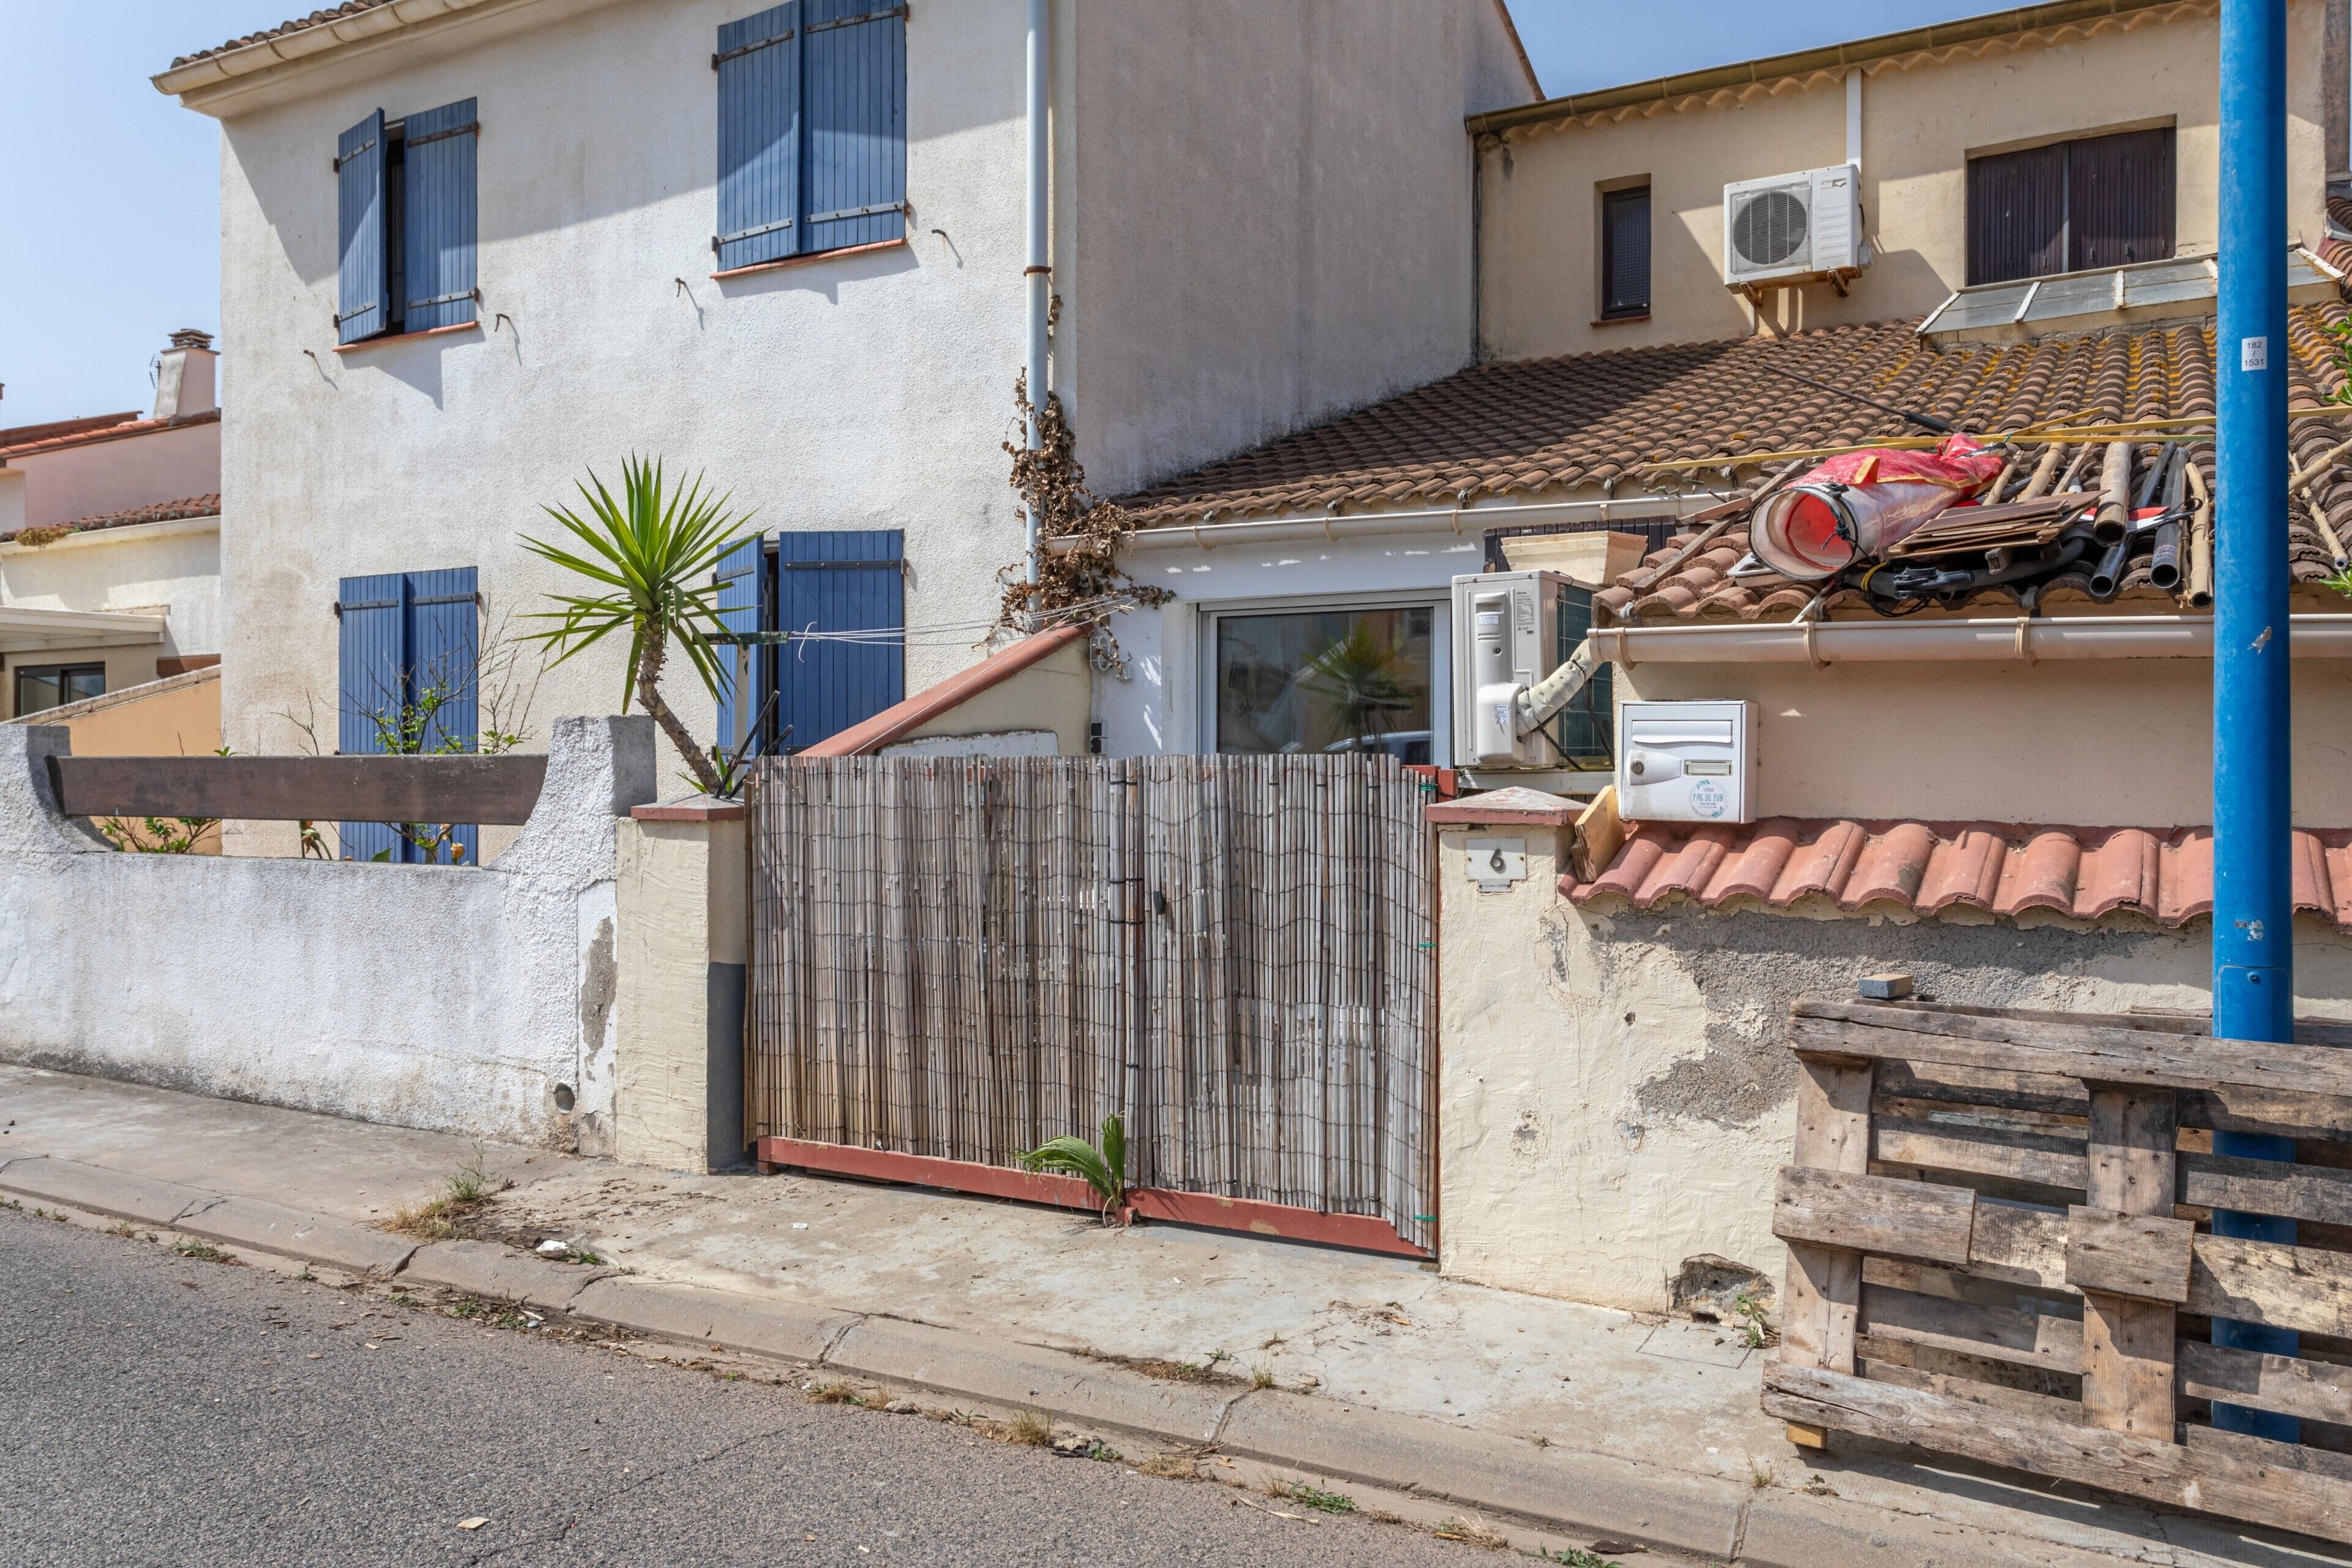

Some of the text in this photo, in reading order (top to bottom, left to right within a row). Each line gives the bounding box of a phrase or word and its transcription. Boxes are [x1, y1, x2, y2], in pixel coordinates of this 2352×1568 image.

[1693, 793, 1724, 802] PAS DE PUB
[1490, 848, 1504, 870] 6
